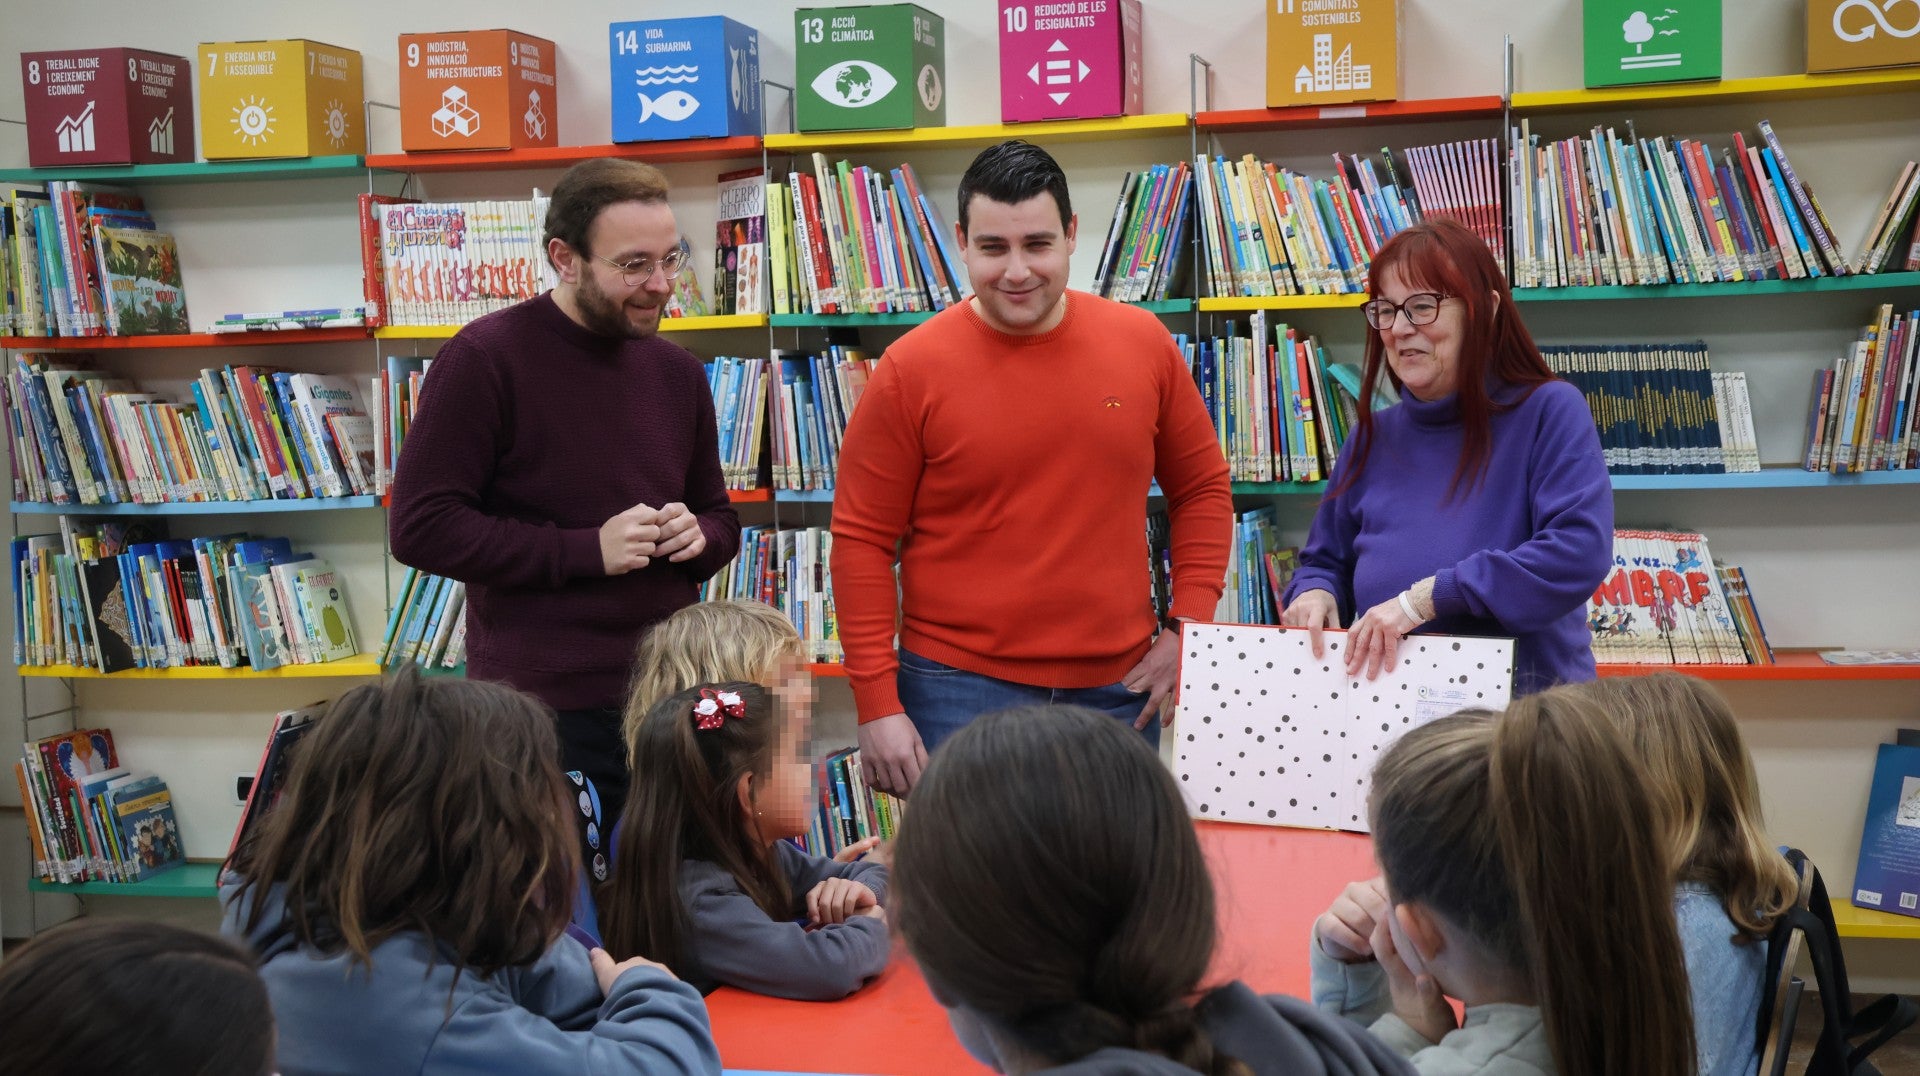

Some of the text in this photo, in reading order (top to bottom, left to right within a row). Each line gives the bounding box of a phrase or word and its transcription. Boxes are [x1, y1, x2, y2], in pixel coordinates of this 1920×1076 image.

[1034, 1, 1107, 17] REDUCCIÓ DE LES
[1302, 0, 1359, 12] COMUNITATS
[831, 15, 856, 28] ACCIÓ
[1004, 6, 1028, 32] 10
[1034, 15, 1095, 31] DESIGUALTATS
[1302, 11, 1361, 27] SOSTENIBLES
[645, 29, 664, 40] VIDA
[801, 17, 824, 43] 13
[831, 28, 874, 42] CLIMÀTICA
[914, 15, 921, 42] 13
[427, 40, 469, 53] INDÚSTRIA,
[616, 30, 639, 55] 14
[645, 41, 692, 54] SUBMARINA
[748, 34, 757, 56] 14
[225, 51, 277, 63] ENERGIA NETA
[407, 43, 420, 67] 9
[427, 53, 468, 66] INNOVACIÓ
[511, 41, 518, 66] 9
[45, 57, 100, 71] TREBALL DIGNE
[128, 57, 138, 82] 8
[140, 59, 161, 73] TREBALL
[207, 53, 218, 77] 7
[225, 64, 274, 76] I ASSEQUIBLE
[308, 51, 316, 76] 7
[427, 65, 503, 79] INFRAESTRUCTURES
[28, 60, 41, 85] 8
[46, 70, 96, 84] I CREIXEMENT
[144, 73, 174, 87] CREIXEMENT
[47, 83, 85, 96] ECONÒMIC
[1780, 160, 1789, 170] DE
[721, 185, 760, 206] CUERPO
[1788, 175, 1808, 206] UNIVERSAL
[720, 201, 759, 219] HUMANO
[1804, 208, 1832, 252] HISTORICO
[313, 385, 353, 403] Gigantes
[303, 403, 329, 471] Gigantes marinos
[1592, 568, 1710, 608] MBRE
[53, 796, 67, 829] Suciedad
